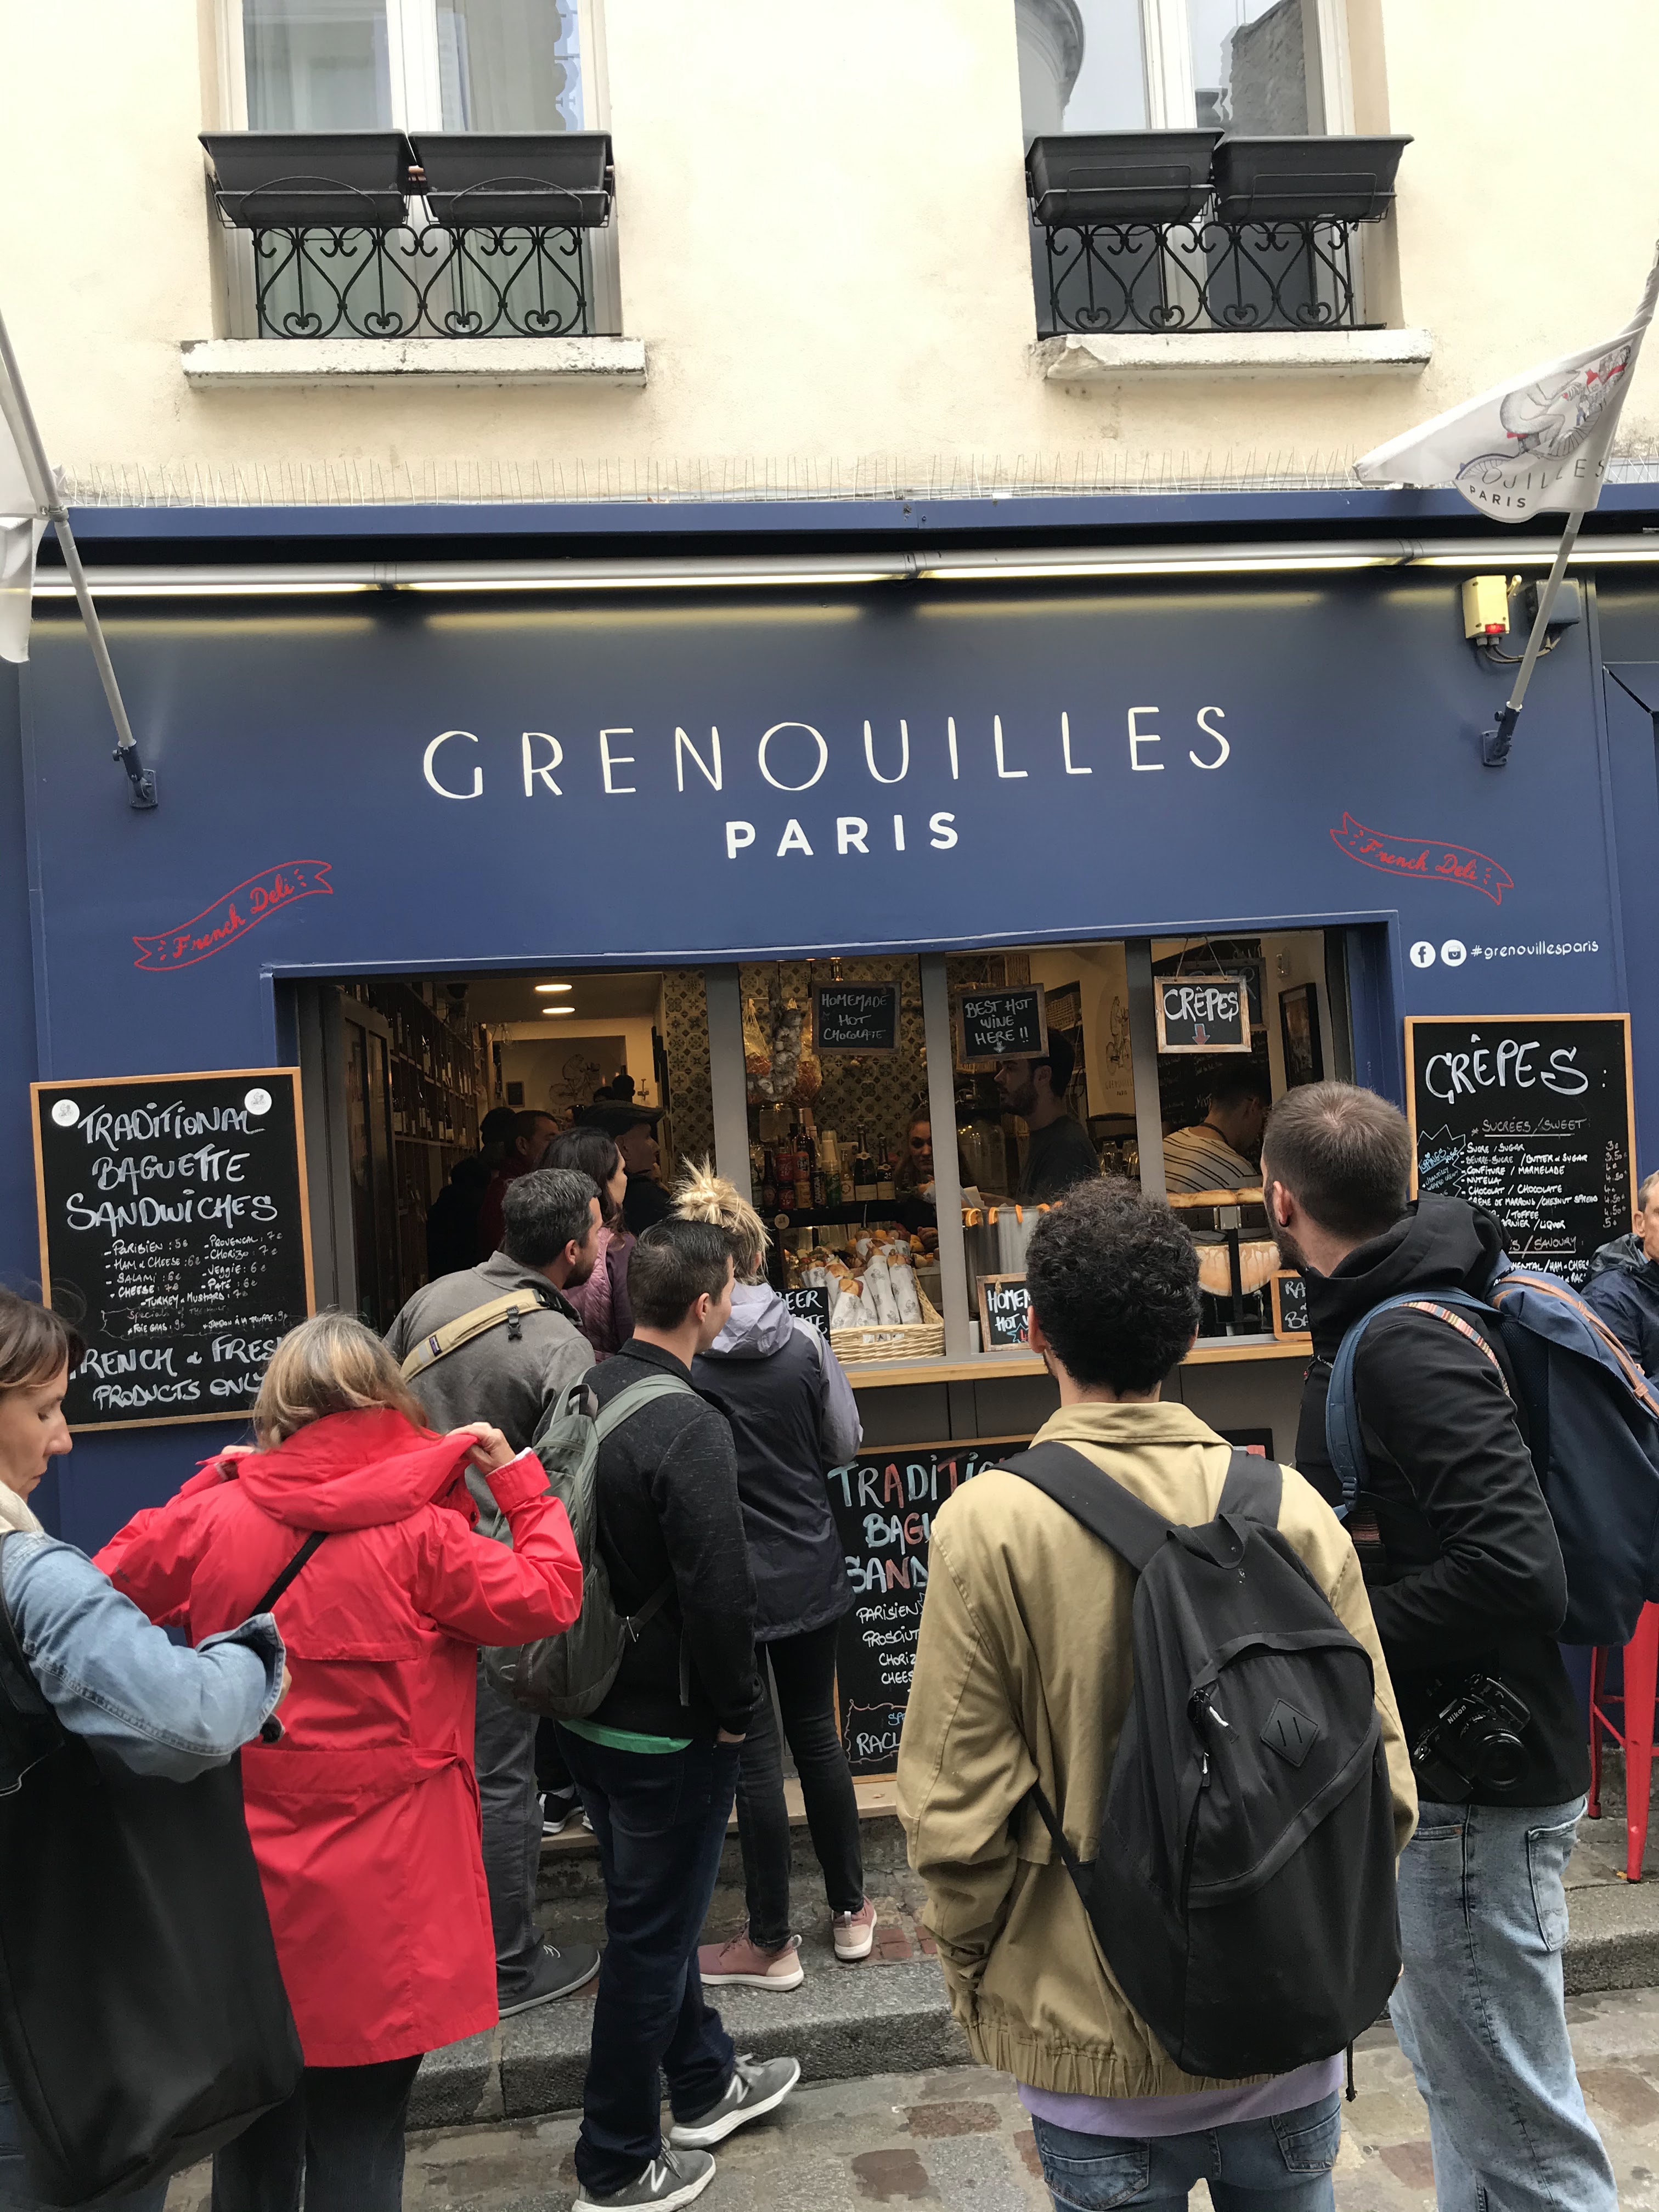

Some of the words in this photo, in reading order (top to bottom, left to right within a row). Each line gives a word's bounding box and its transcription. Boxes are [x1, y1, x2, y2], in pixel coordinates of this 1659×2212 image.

[1470, 485, 1526, 508] PARIS
[424, 706, 1231, 799] GRENOUILLES
[725, 812, 960, 859] PARIS
[1360, 839, 1430, 872] French
[1436, 854, 1477, 881] Deli
[172, 903, 246, 958] French
[250, 874, 295, 915] Deli
[1471, 940, 1599, 960] #grenouillesparis
[822, 994, 890, 1012] HOMEMADE
[965, 1000, 1002, 1018] BEST
[1005, 998, 1032, 1015] HOT
[1164, 986, 1239, 1022] CRÊPES
[838, 1014, 872, 1026] HOT
[980, 1015, 1014, 1029] WINE
[975, 1028, 1015, 1046] HERE
[1426, 1034, 1589, 1104] CRÊPES
[77, 1100, 266, 1151] TRADITIONAL
[1482, 1116, 1531, 1133] SUCRÉES
[1544, 1119, 1588, 1130] SWEET
[1466, 1142, 1489, 1153] SUCRE
[1465, 1155, 1514, 1165] BEURRE-SUCRE
[1562, 1153, 1588, 1163] SUGAR
[92, 1143, 250, 1195] BAGUETTE
[1467, 1166, 1505, 1176] CONFITURE
[1518, 1165, 1565, 1175] MARMELADE
[1466, 1177, 1502, 1185] NUTELLA
[1468, 1186, 1505, 1195] CHOCOLAT
[1517, 1184, 1562, 1194] CHOCOLATE
[1494, 1198, 1503, 1206] DE
[1505, 1197, 1536, 1206] MARRONS
[66, 1189, 278, 1237] SANDWICHES
[1534, 1235, 1577, 1250] SAVOURY
[114, 1258, 137, 1271] HAM
[148, 1256, 180, 1268] CHEESE
[210, 1249, 249, 1260] CHORIZO
[117, 1272, 157, 1284] SALAMI
[145, 1294, 179, 1309] TURKEY
[133, 1323, 148, 1333] FOIE
[208, 1319, 232, 1329] JAMBON
[995, 1313, 1020, 1332] HOT
[70, 1347, 178, 1380] RENCH
[93, 1378, 201, 1410] PRODUCTS
[827, 1450, 1006, 1508] TRADITI
[856, 1602, 919, 1624] PARISIEN
[1447, 1704, 1468, 1725] Nikon
